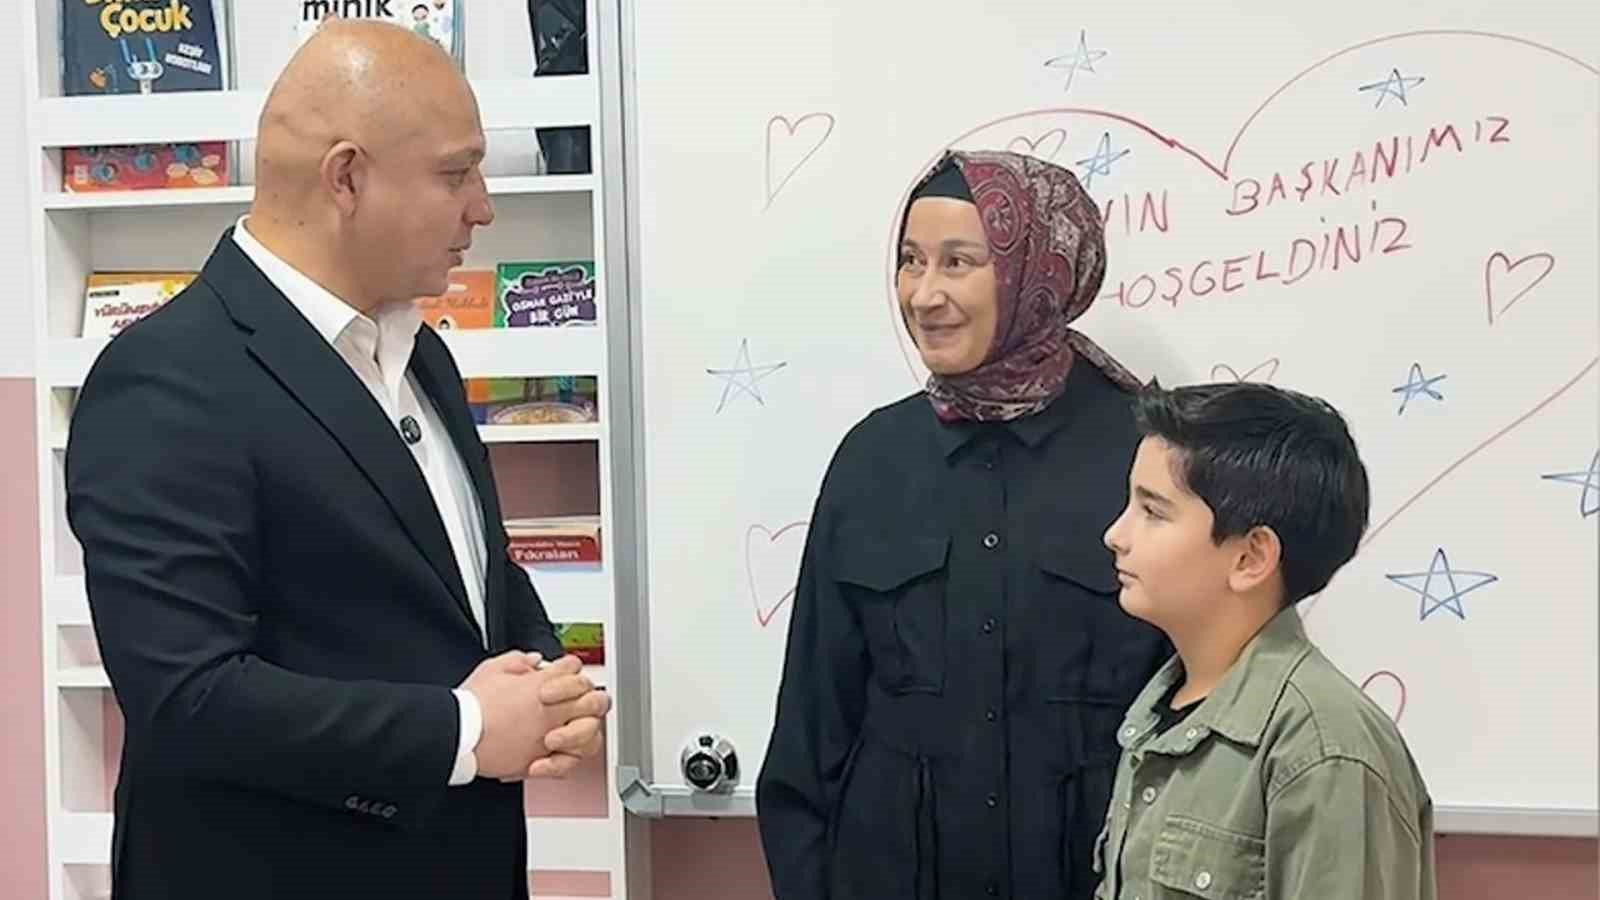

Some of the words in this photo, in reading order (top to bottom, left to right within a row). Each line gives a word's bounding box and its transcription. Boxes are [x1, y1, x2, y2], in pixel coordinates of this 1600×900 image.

[100, 0, 193, 38] Çocuk
[1225, 116, 1510, 216] BAŞKANIMIZ
[554, 304, 580, 319] GÜN
